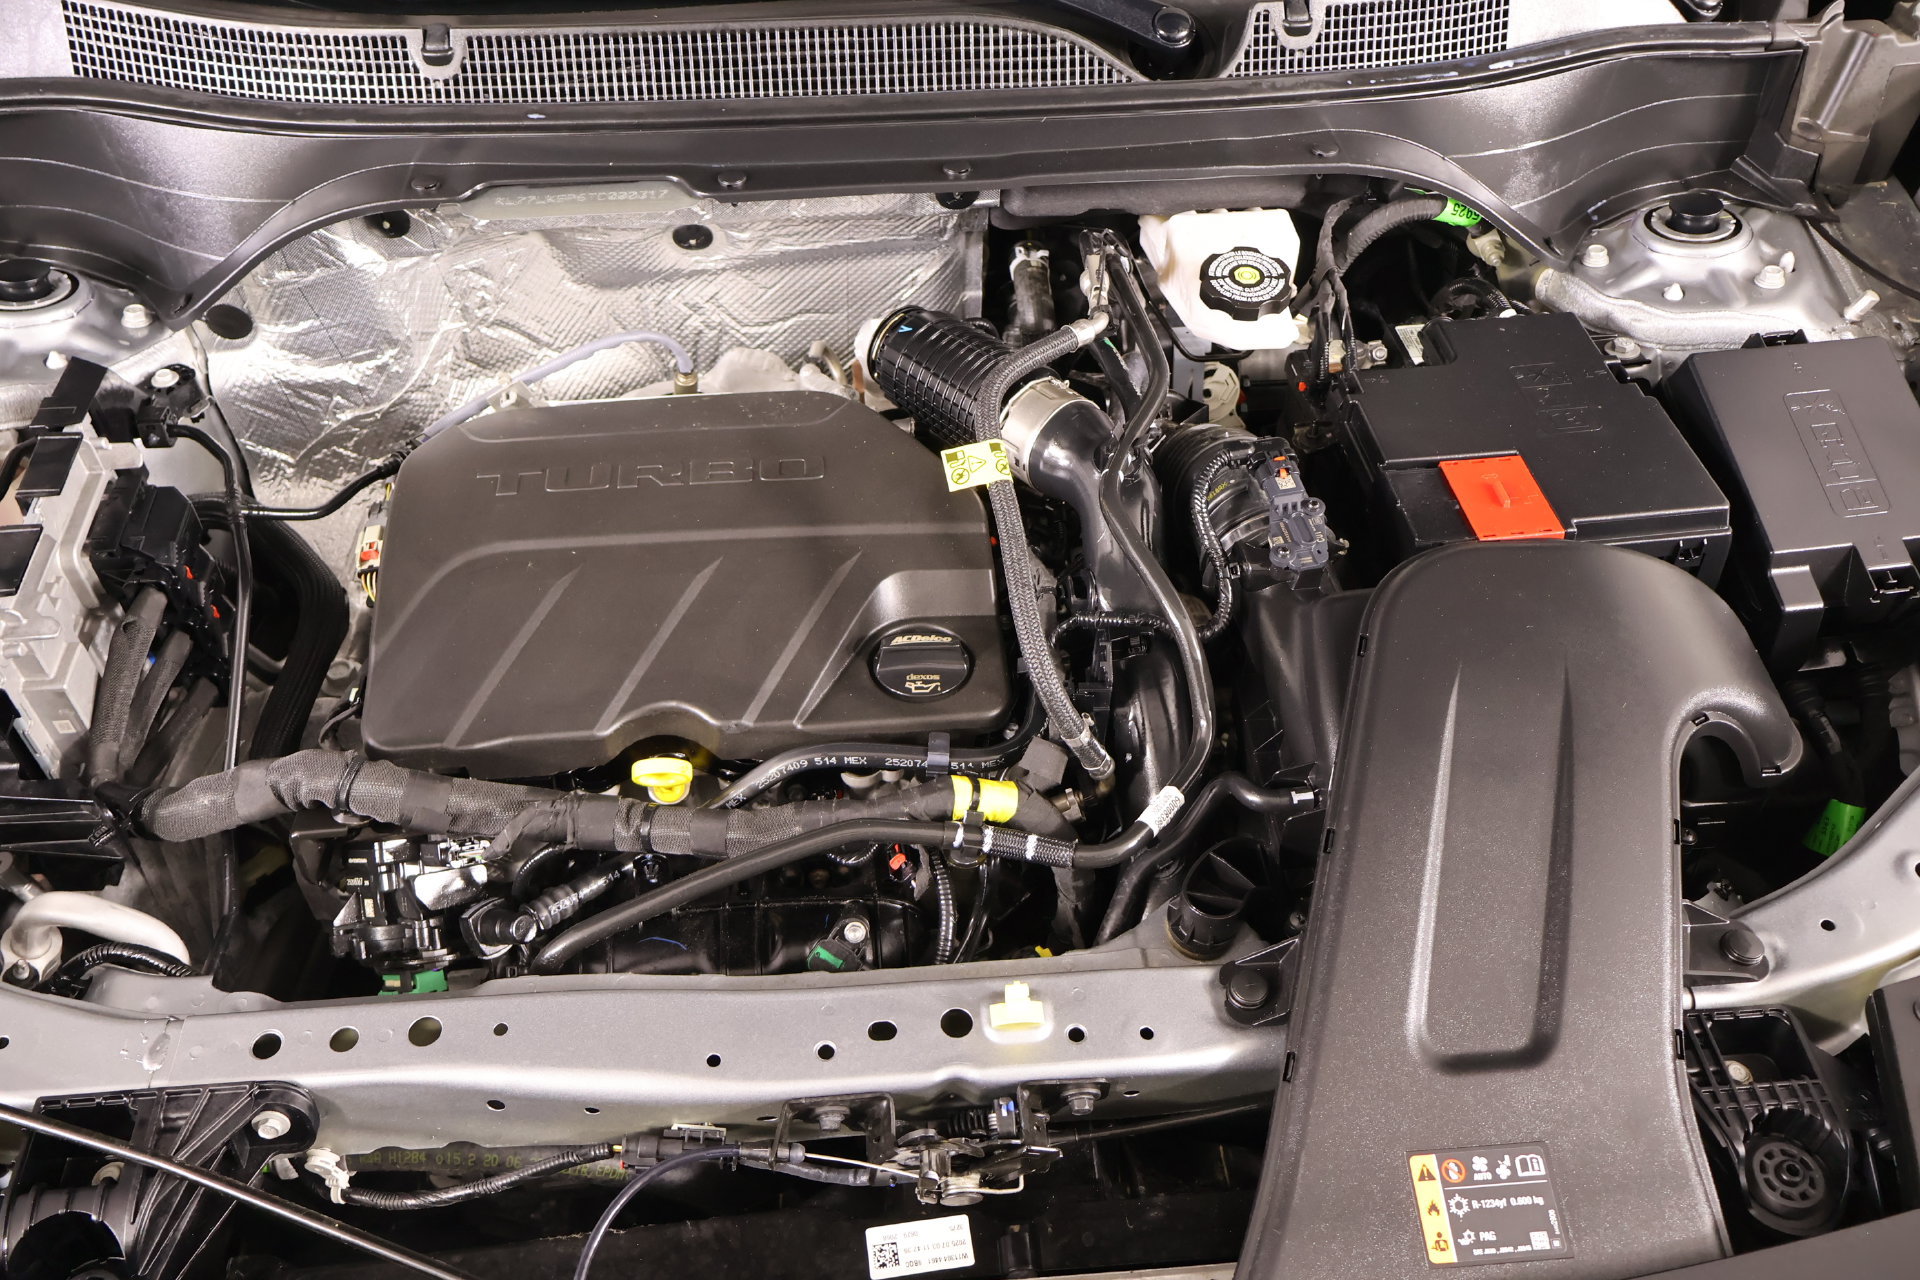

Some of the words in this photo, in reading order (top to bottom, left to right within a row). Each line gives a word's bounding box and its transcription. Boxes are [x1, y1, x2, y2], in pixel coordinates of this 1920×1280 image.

[476, 457, 825, 496] TURBO
[890, 634, 952, 646] ACDelco
[906, 673, 940, 681] dexos
[726, 792, 747, 810] MEX
[755, 760, 808, 790] 25207409
[814, 756, 837, 766] 514
[844, 756, 867, 766] MEX
[1473, 1171, 1493, 1181] AUTO
[1532, 1195, 1544, 1206] kg
[1479, 1231, 1497, 1242] PAG
